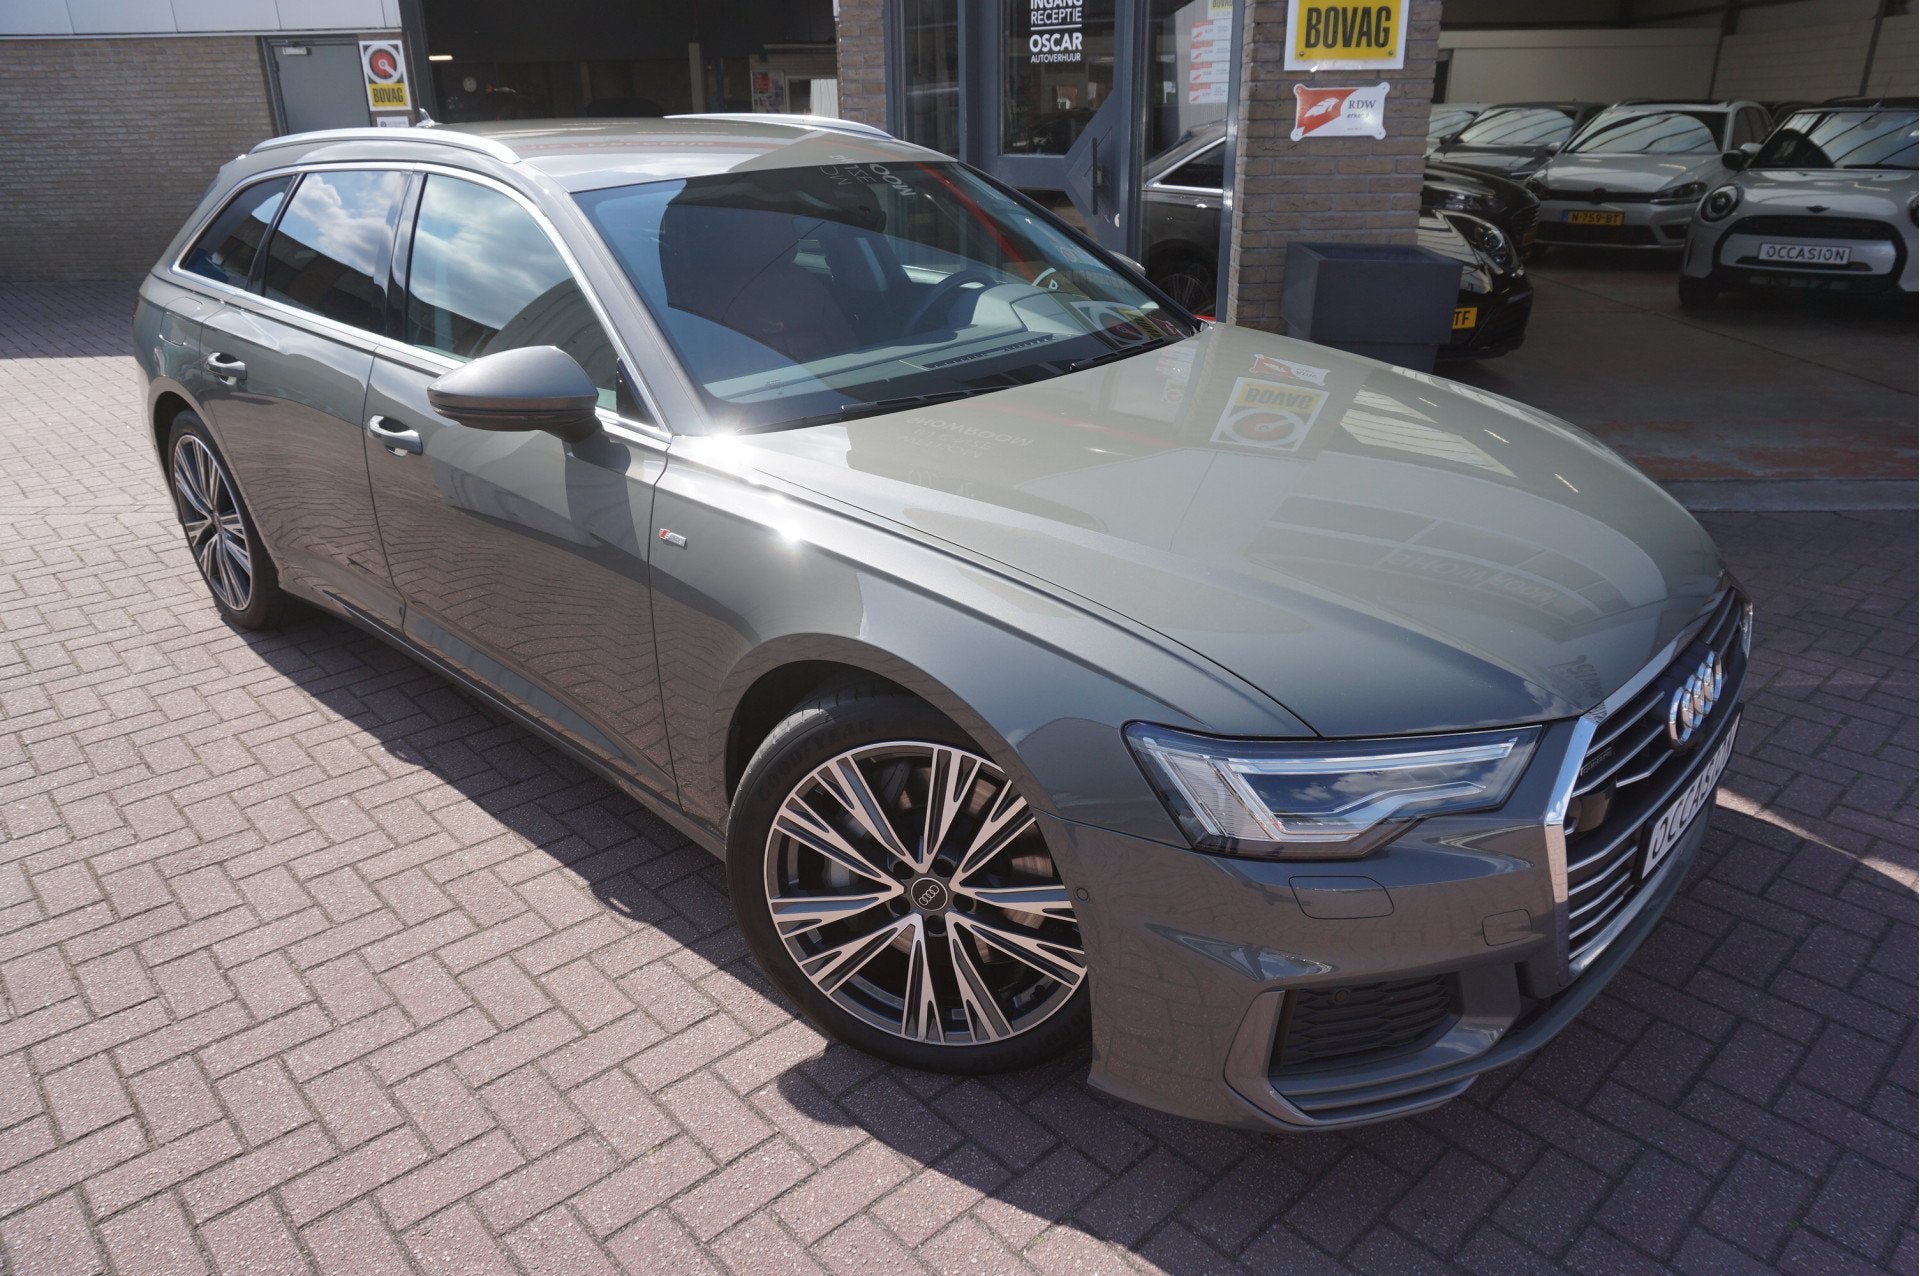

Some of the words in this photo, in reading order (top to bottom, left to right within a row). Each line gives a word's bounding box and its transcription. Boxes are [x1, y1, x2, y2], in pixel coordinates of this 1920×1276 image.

[1030, 8, 1082, 24] RECEPTIE
[1305, 6, 1391, 48] BOVAG
[1029, 32, 1082, 52] OSCAR
[1030, 53, 1081, 63] AUTOVERHUUR
[373, 88, 404, 103] BOVAG
[1347, 99, 1377, 110] RDW
[1766, 245, 1846, 261] OCCASION
